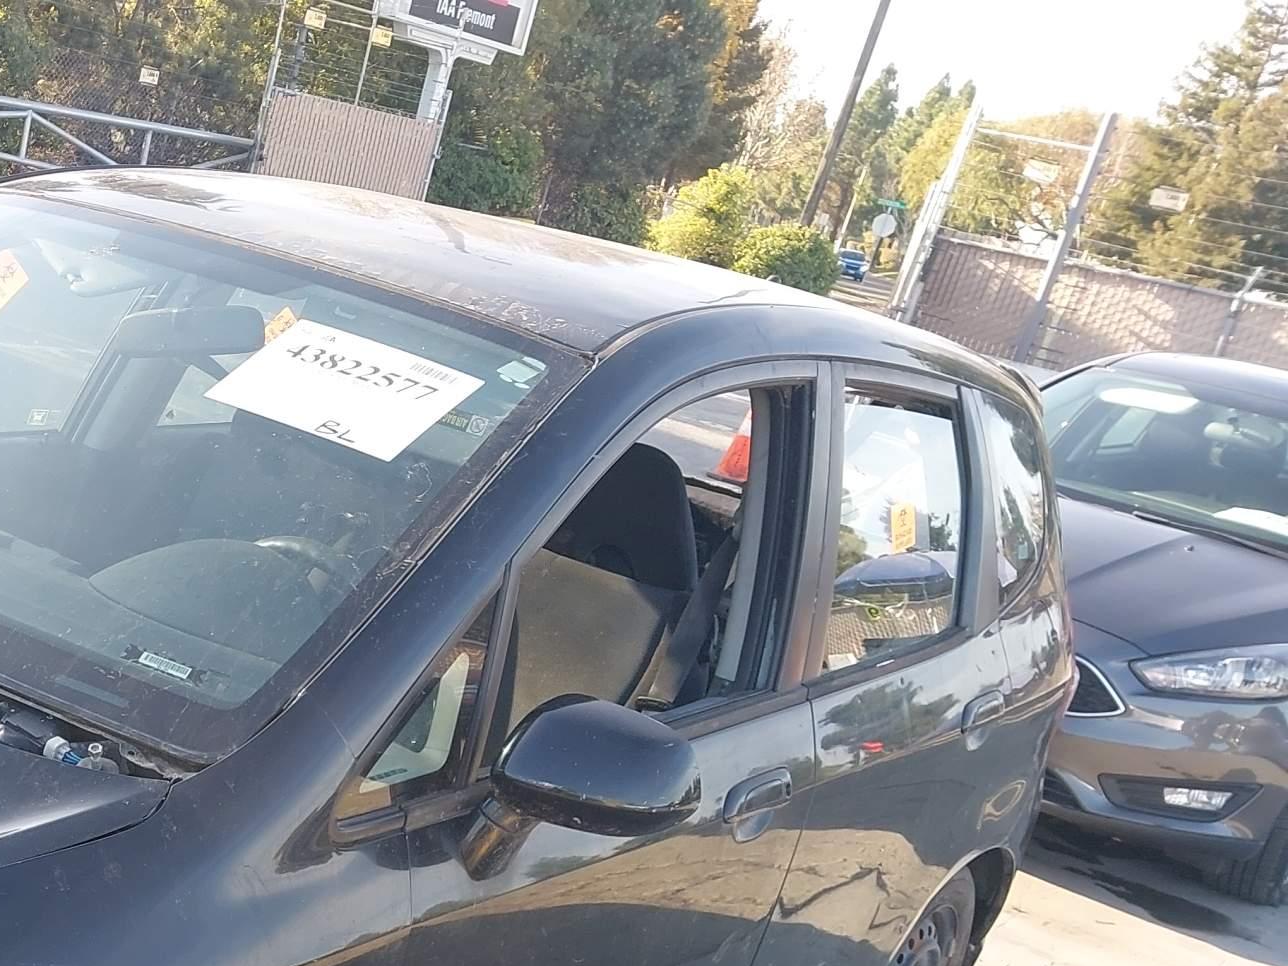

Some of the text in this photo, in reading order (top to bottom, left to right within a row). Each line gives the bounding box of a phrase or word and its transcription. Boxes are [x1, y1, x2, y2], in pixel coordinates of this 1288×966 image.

[456, 1, 496, 30] Femont
[286, 345, 439, 400] 43822577
[314, 420, 355, 443] BL
